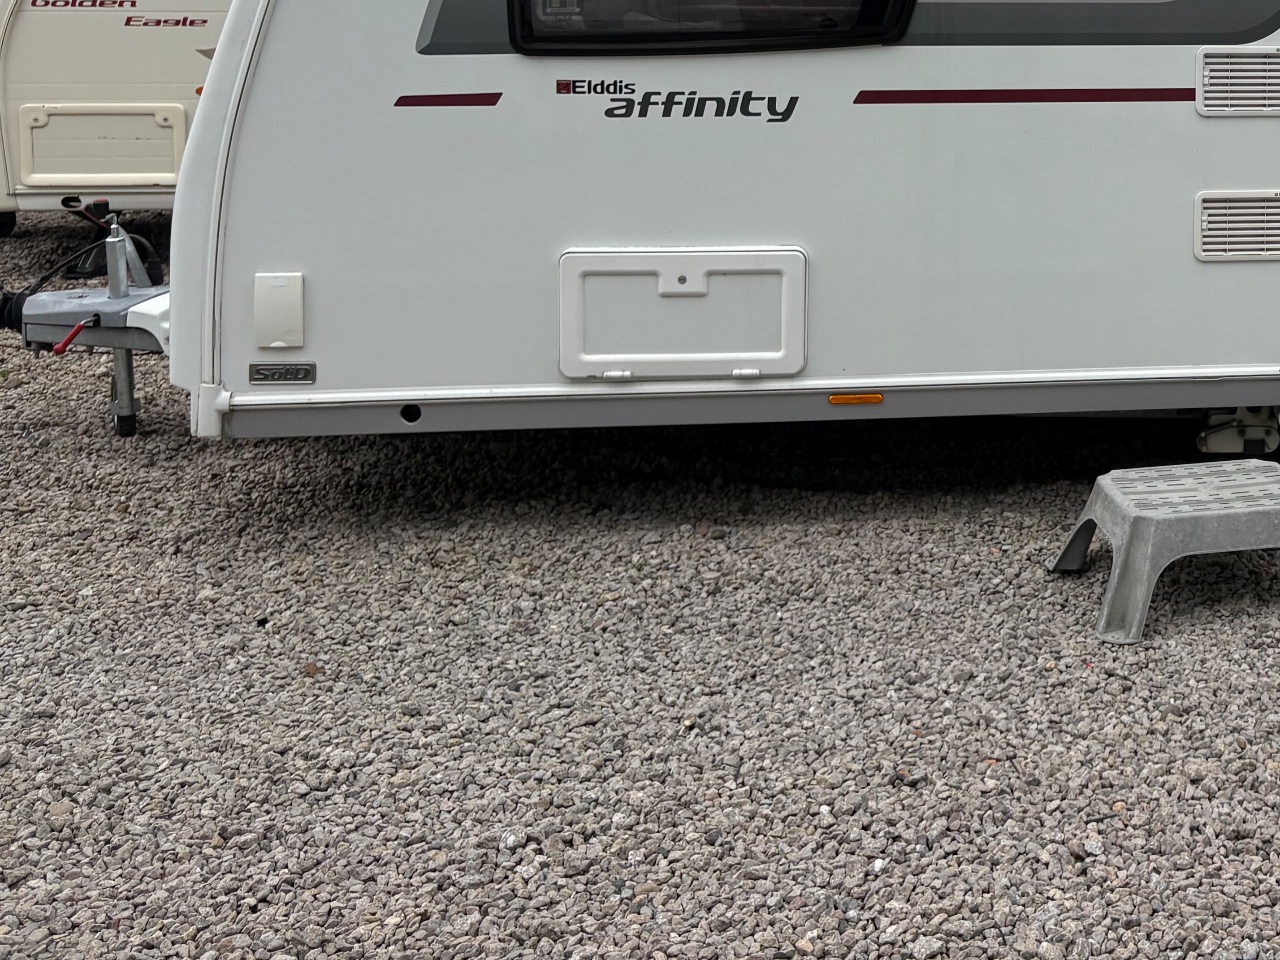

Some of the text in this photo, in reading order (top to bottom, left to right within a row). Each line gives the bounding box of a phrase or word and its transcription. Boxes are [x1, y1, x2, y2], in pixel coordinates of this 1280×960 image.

[124, 15, 209, 28] Eagle
[571, 79, 636, 95] Elddis
[604, 90, 800, 123] affinity
